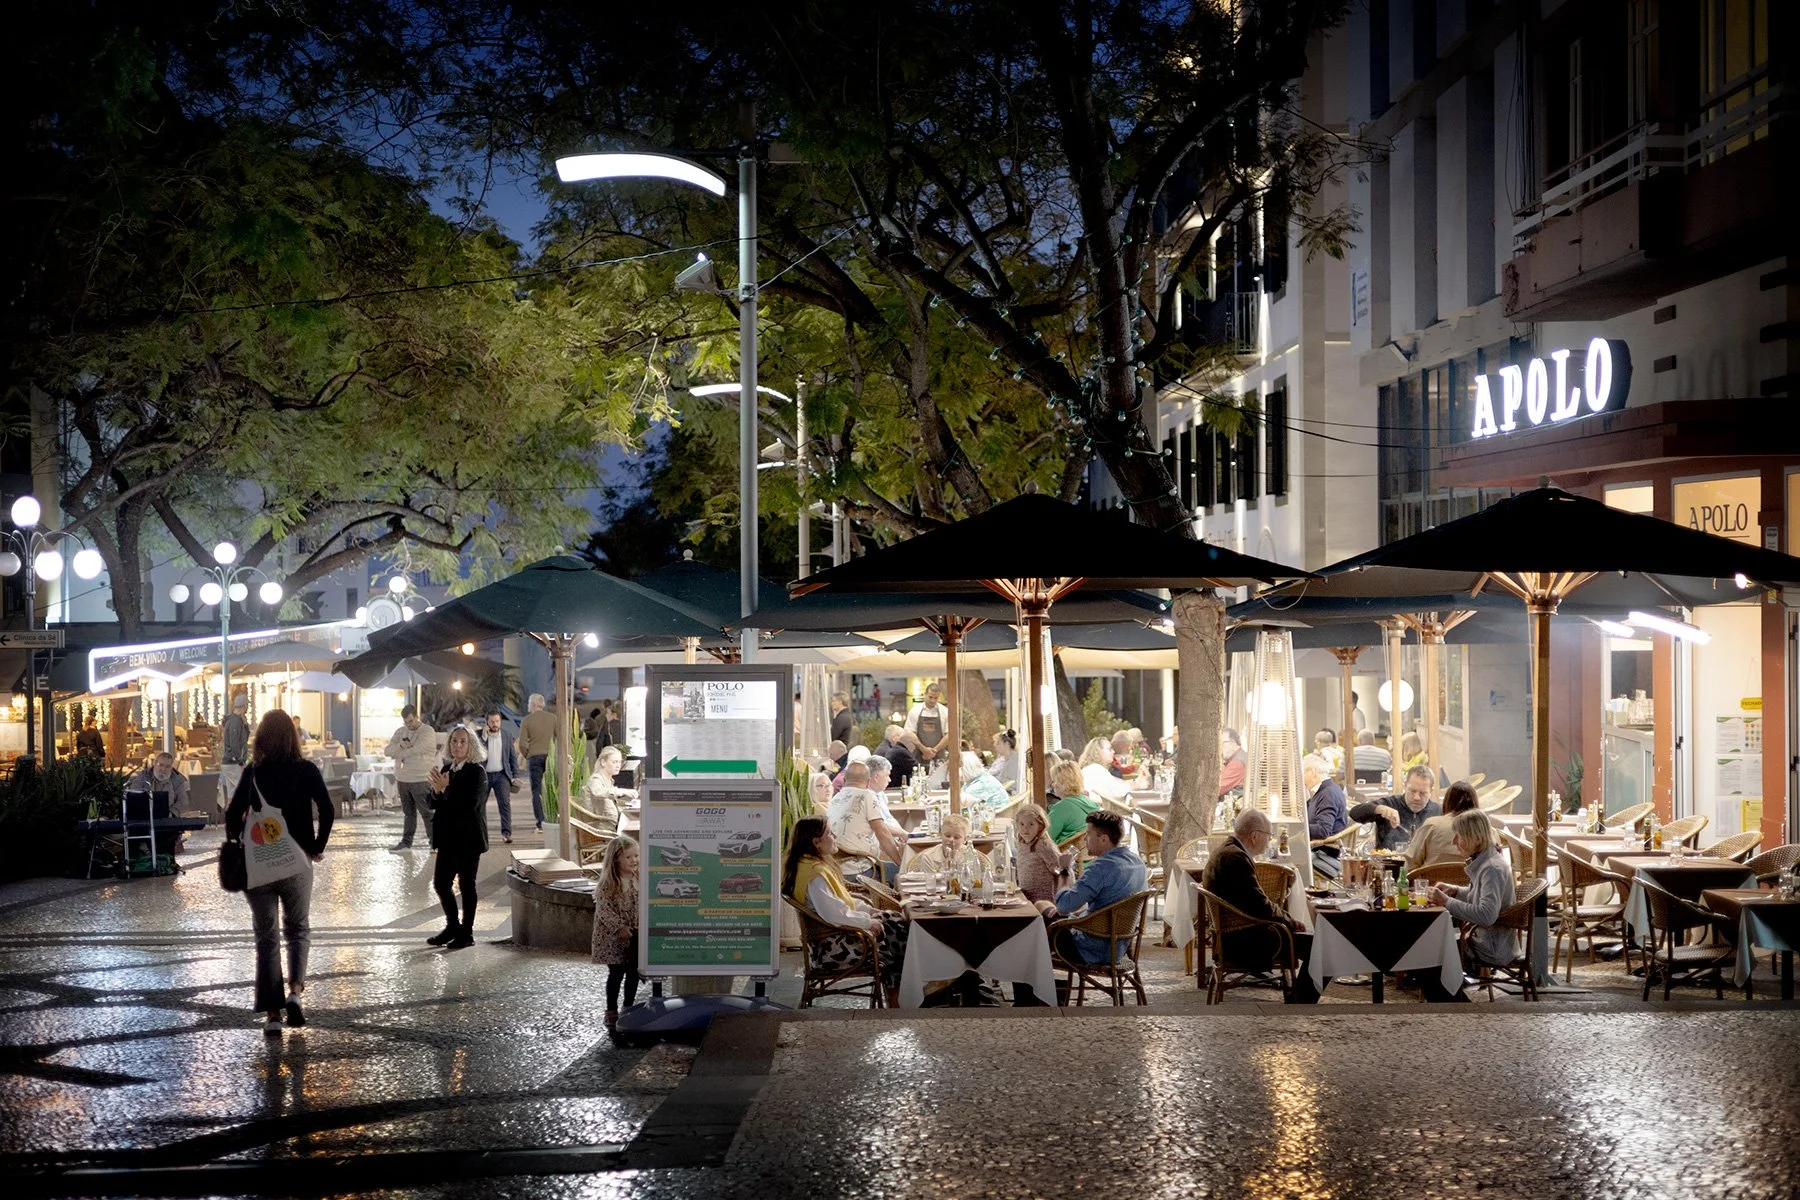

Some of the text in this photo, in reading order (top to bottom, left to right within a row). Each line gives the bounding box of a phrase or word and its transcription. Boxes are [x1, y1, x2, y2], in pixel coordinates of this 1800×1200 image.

[1471, 337, 1613, 438] APOLO
[1689, 503, 1749, 534] APOLO
[129, 650, 167, 667] BEM-VINDO
[179, 645, 208, 660] WELCOME
[707, 682, 744, 691] POLO
[710, 704, 728, 714] MENU
[695, 807, 727, 815] GOGO
